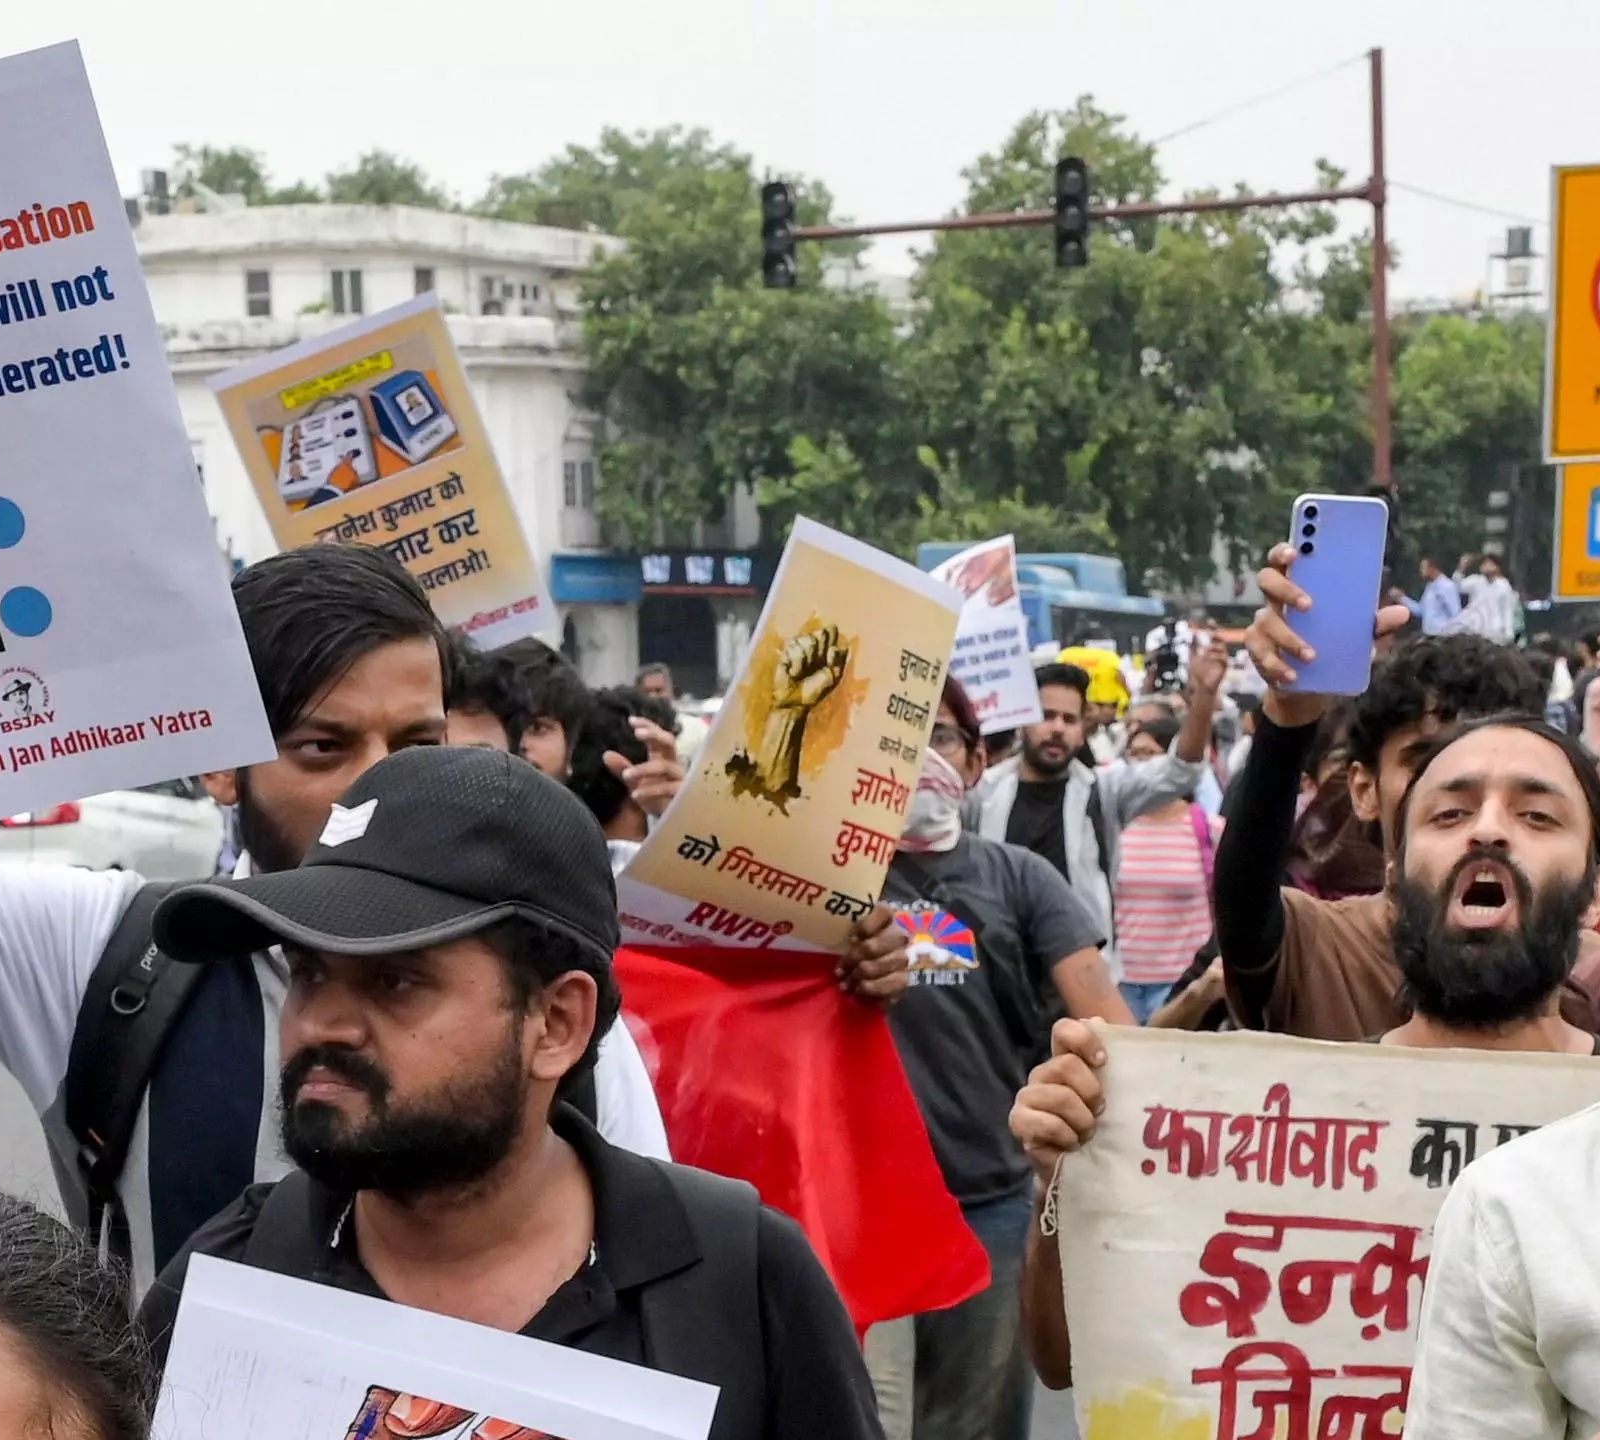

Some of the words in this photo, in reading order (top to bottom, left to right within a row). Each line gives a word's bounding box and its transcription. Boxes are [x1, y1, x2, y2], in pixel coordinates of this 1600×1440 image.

[51, 266, 114, 313] not
[434, 509, 479, 544] कर
[0, 710, 55, 733] BSJAY
[8, 740, 45, 774] Jan
[50, 720, 146, 758] Adhikaar
[150, 708, 212, 738] Yatra
[677, 833, 721, 866] को
